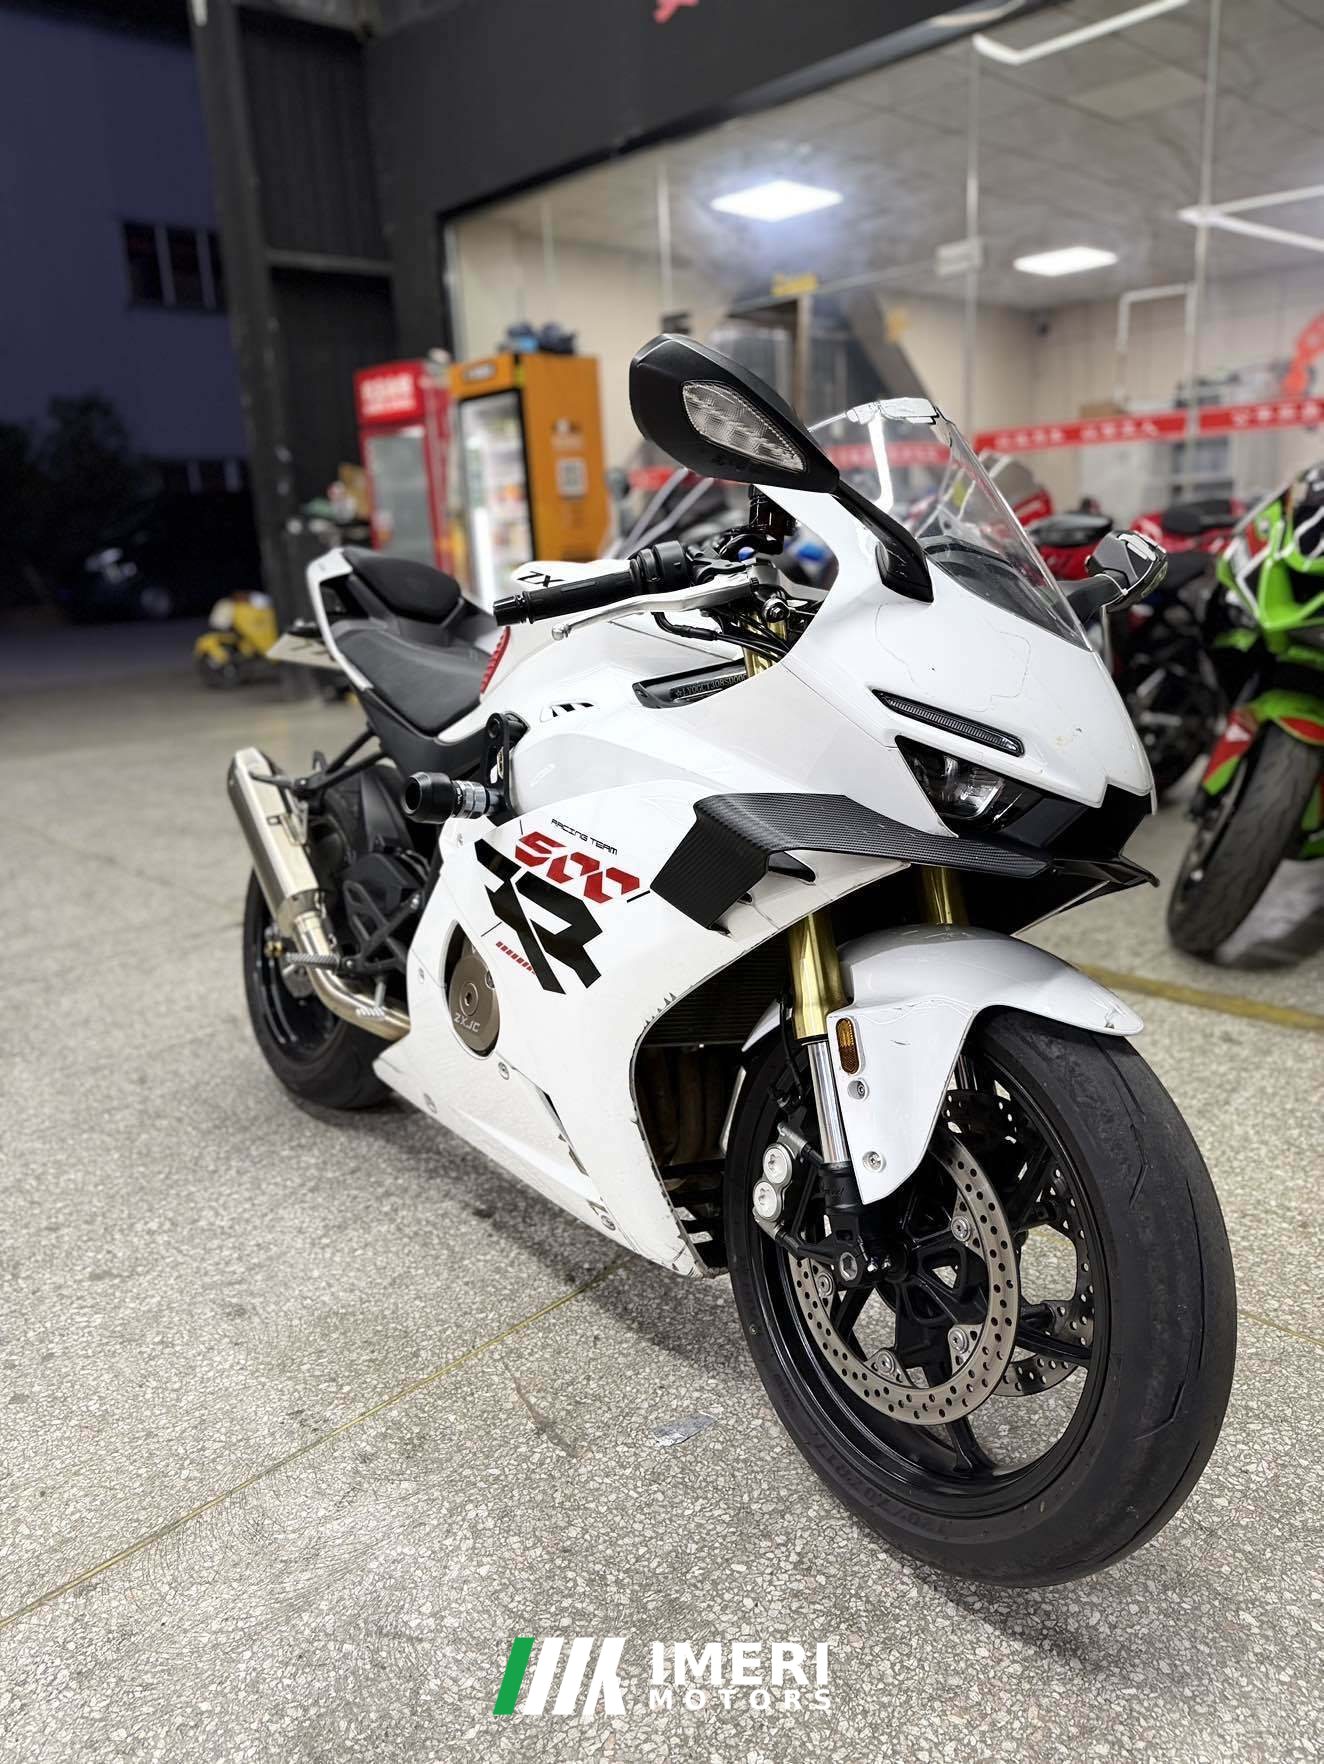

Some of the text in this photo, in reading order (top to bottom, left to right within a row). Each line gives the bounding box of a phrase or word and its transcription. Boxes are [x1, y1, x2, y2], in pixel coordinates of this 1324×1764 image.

[551, 818, 618, 856] RACING TEAM
[514, 831, 639, 904] 500
